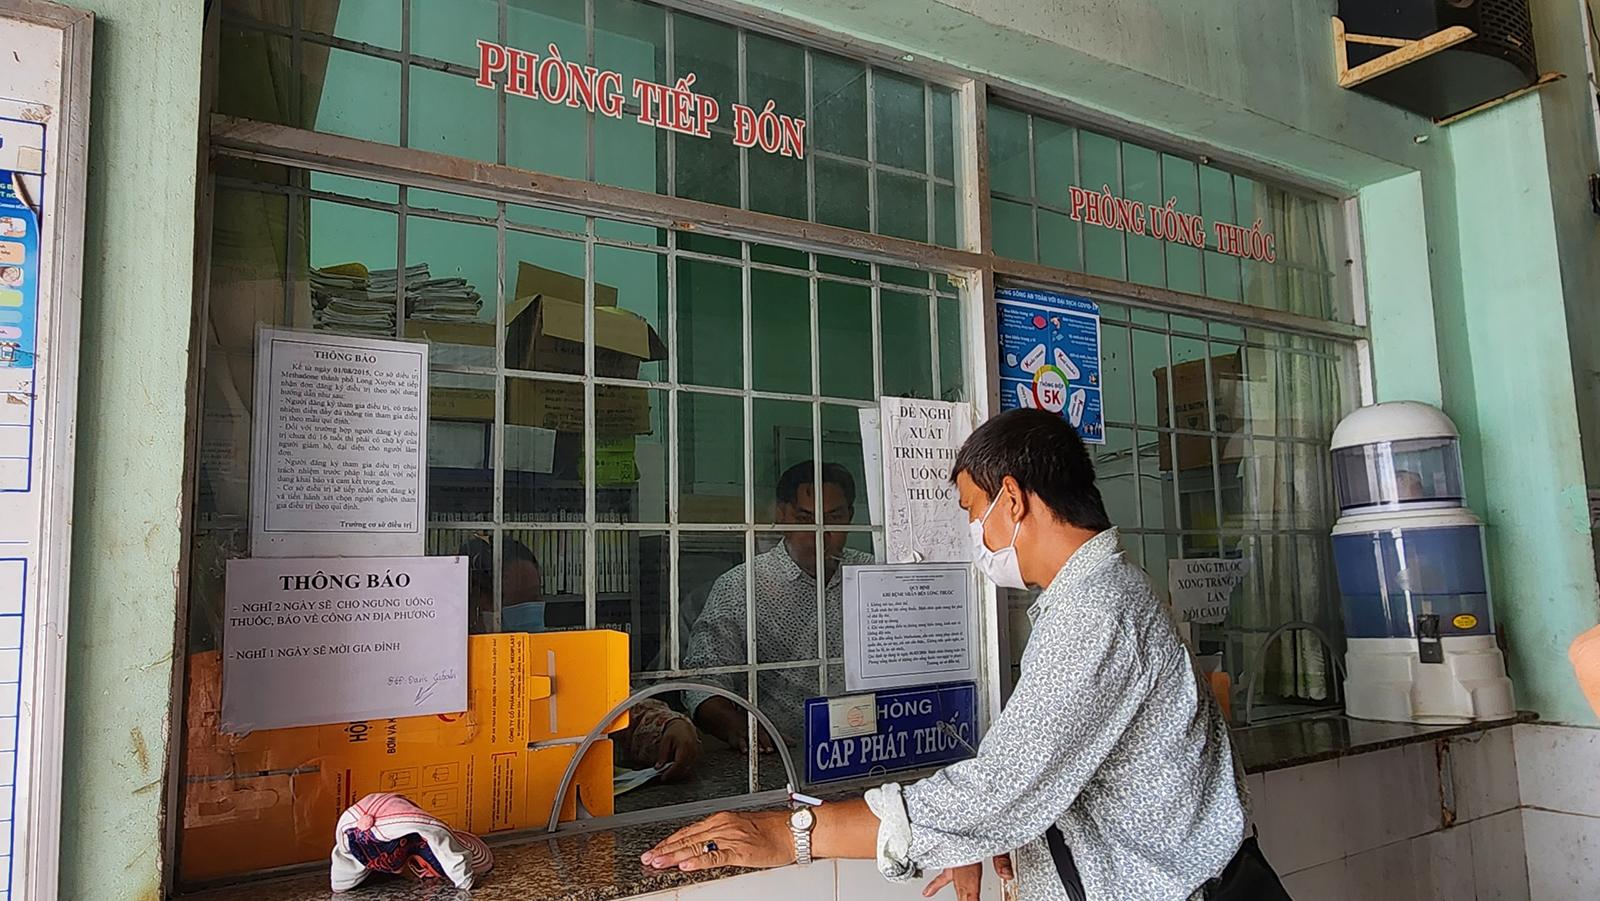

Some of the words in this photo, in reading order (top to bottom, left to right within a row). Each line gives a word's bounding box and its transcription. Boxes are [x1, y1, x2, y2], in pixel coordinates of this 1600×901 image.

[476, 40, 625, 118] PHÒNG
[633, 74, 718, 138] TIẾP
[732, 100, 806, 159] ĐÓN
[1068, 184, 1146, 236] PHÒNG
[1149, 196, 1206, 248] UỐNG
[1214, 218, 1276, 264] THUỐC
[314, 350, 353, 361] THÔNG
[281, 371, 319, 380] Methadone
[356, 377, 373, 385] Long
[1044, 390, 1061, 406] 5K
[920, 407, 951, 422] NGHỊ
[910, 424, 943, 439] XUẤT
[893, 444, 933, 459] TRÌNH
[911, 464, 948, 480] UỐNG
[907, 484, 952, 500] THUỐC
[280, 570, 360, 590] THÔNG
[366, 570, 410, 588] BÁO
[1178, 579, 1204, 590] XONG
[242, 601, 272, 612] NGHĨ
[275, 602, 280, 611] 2
[283, 600, 316, 611] NGÀY
[318, 600, 332, 610] SẼ
[337, 600, 360, 609] CHO
[406, 596, 434, 607] UỐNG
[230, 615, 274, 626] THUỐC,
[277, 614, 301, 624] BÁO
[304, 614, 319, 624] VỀ
[321, 612, 352, 623] CÔNG
[355, 613, 370, 622] AN
[373, 612, 391, 622] ĐỊA
[394, 610, 436, 620] PHƯƠNG
[236, 648, 266, 659] NGHĨ
[270, 649, 274, 657] 1
[278, 646, 310, 657] NGÀY
[313, 645, 327, 656] SẼ
[329, 644, 350, 654] MỜI
[353, 643, 371, 653] GIA
[375, 641, 400, 652] ĐÌNH
[876, 698, 932, 720] HÒNG
[860, 725, 908, 764] PHÁT
[914, 711, 970, 755] THUỐC
